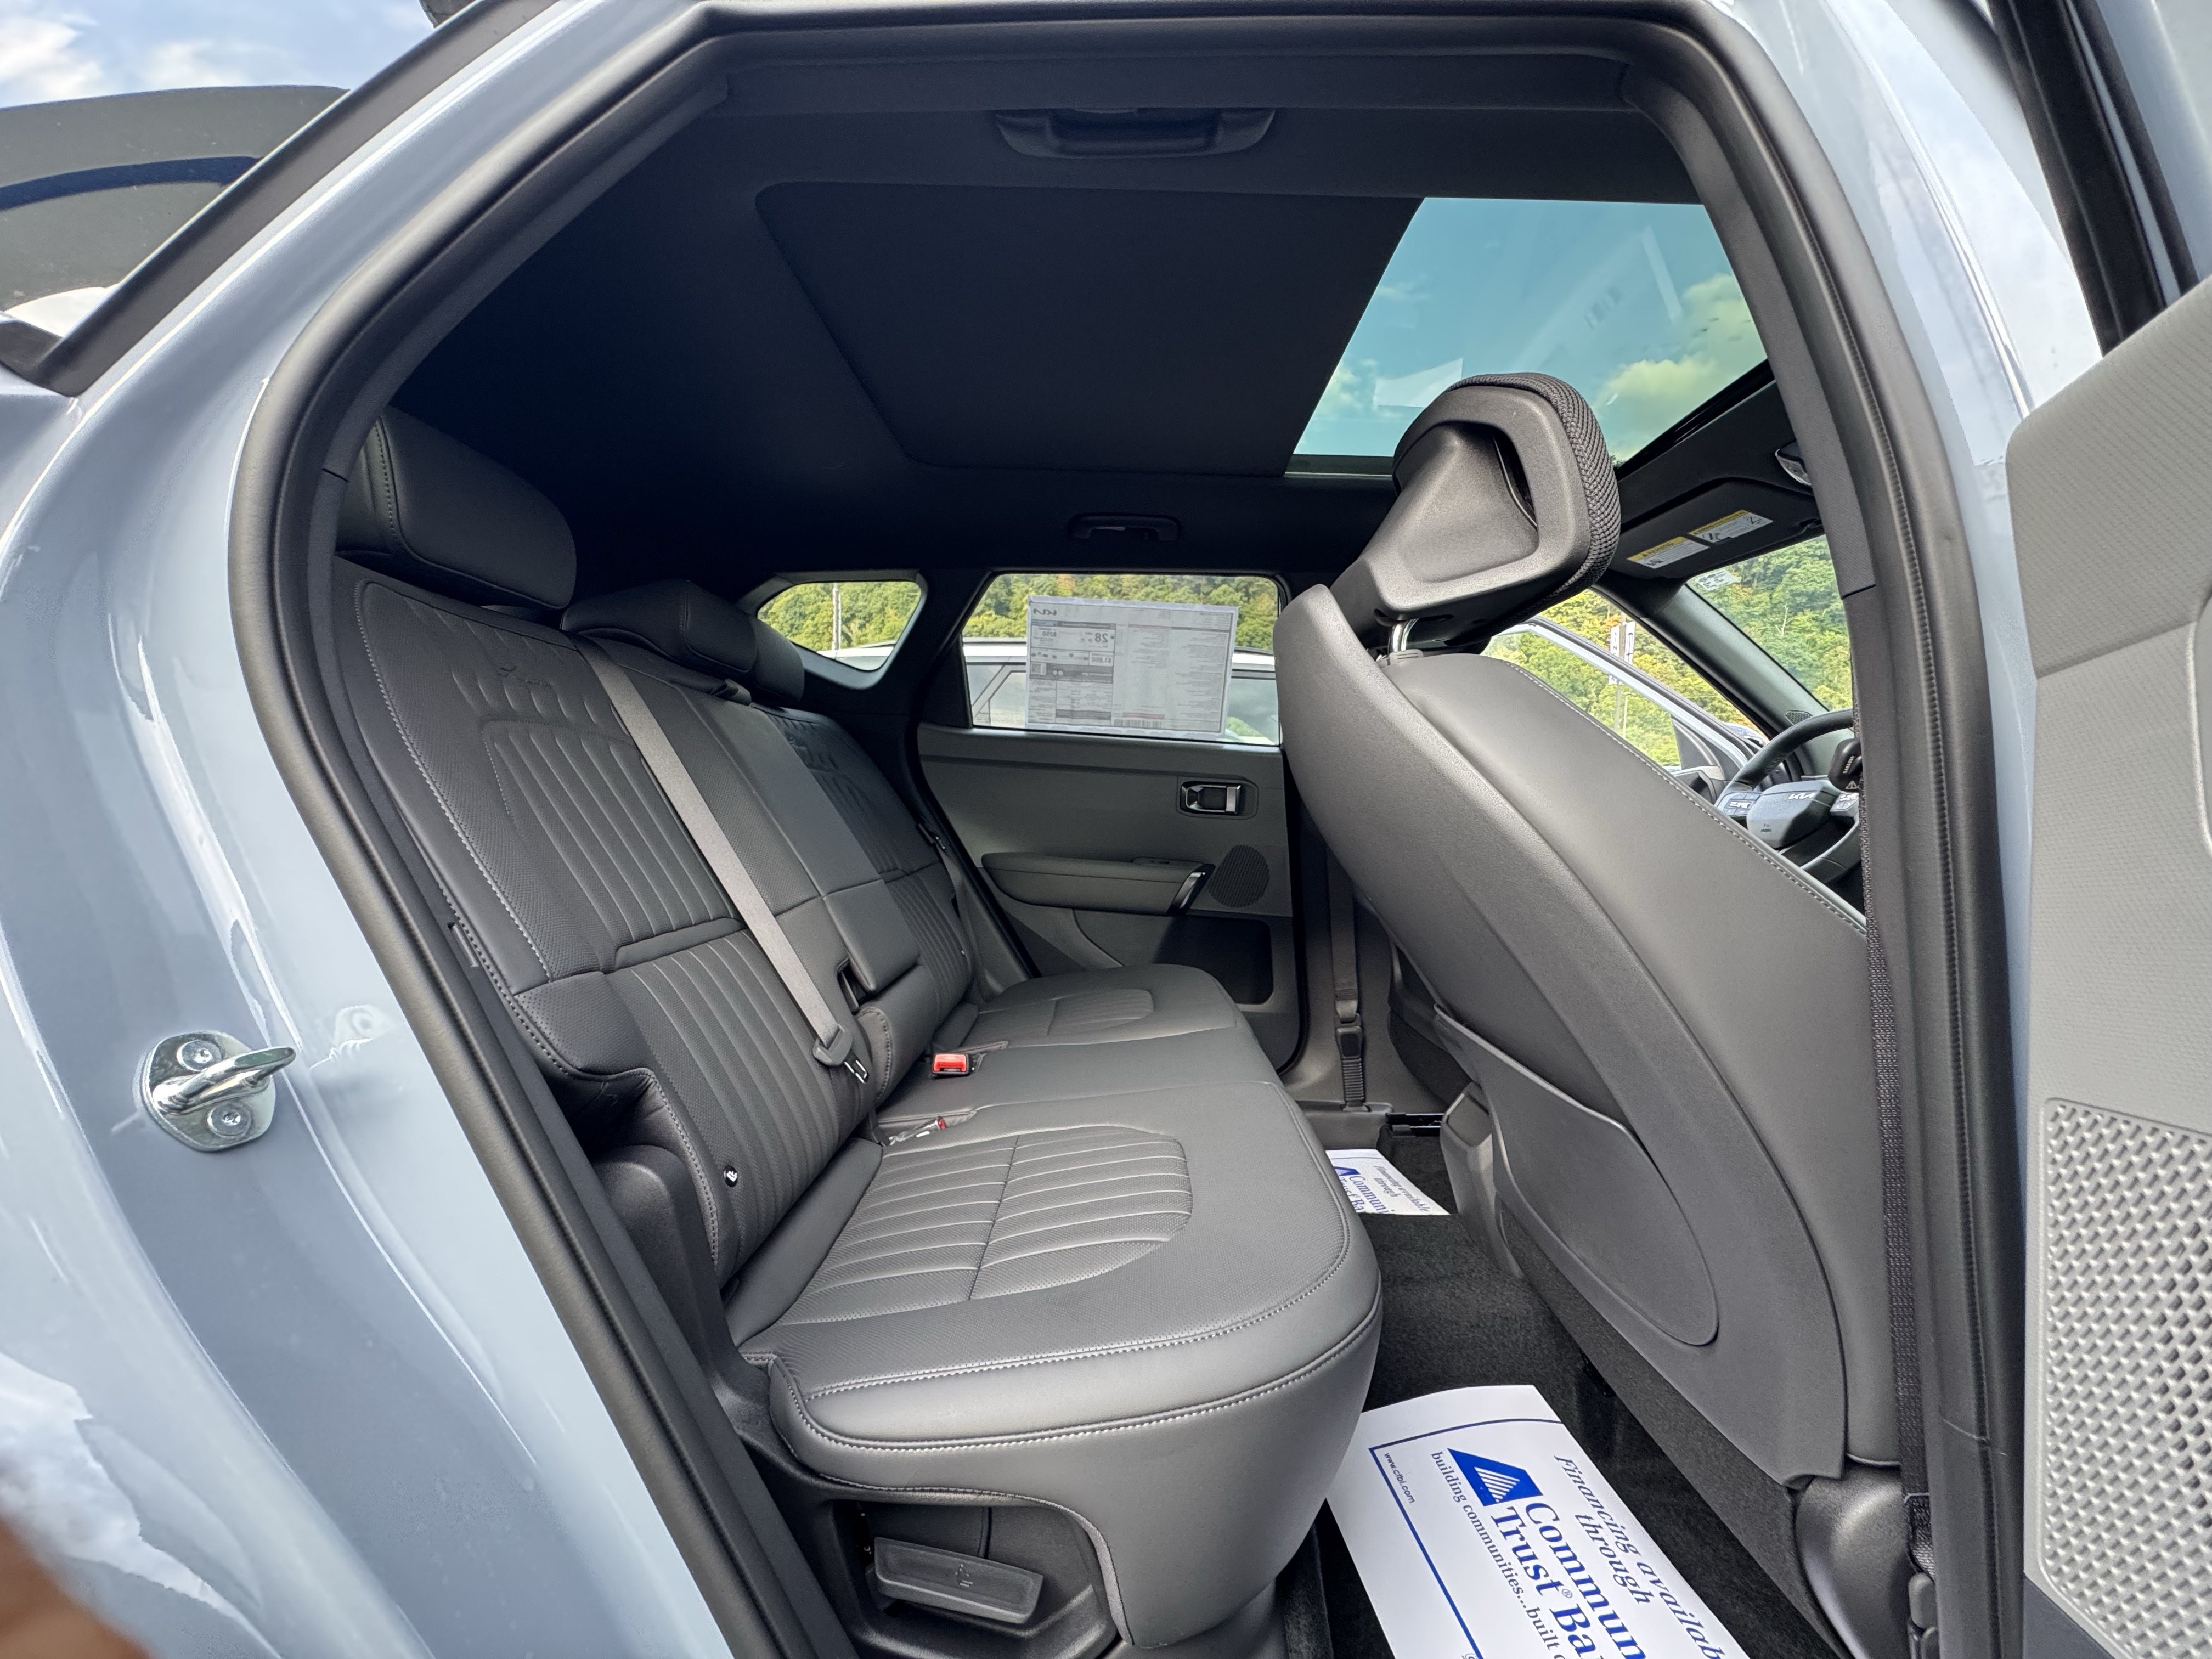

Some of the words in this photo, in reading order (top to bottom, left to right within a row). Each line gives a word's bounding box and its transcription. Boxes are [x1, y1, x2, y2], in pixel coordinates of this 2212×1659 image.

[1373, 1178, 1401, 1197] through
[1384, 1452, 1415, 1504] www.ctbi.com
[1431, 1451, 1468, 1503] building
[1553, 1455, 1642, 1557] Financing
[1574, 1514, 1655, 1605] through
[1549, 1603, 1605, 1659] Ba
